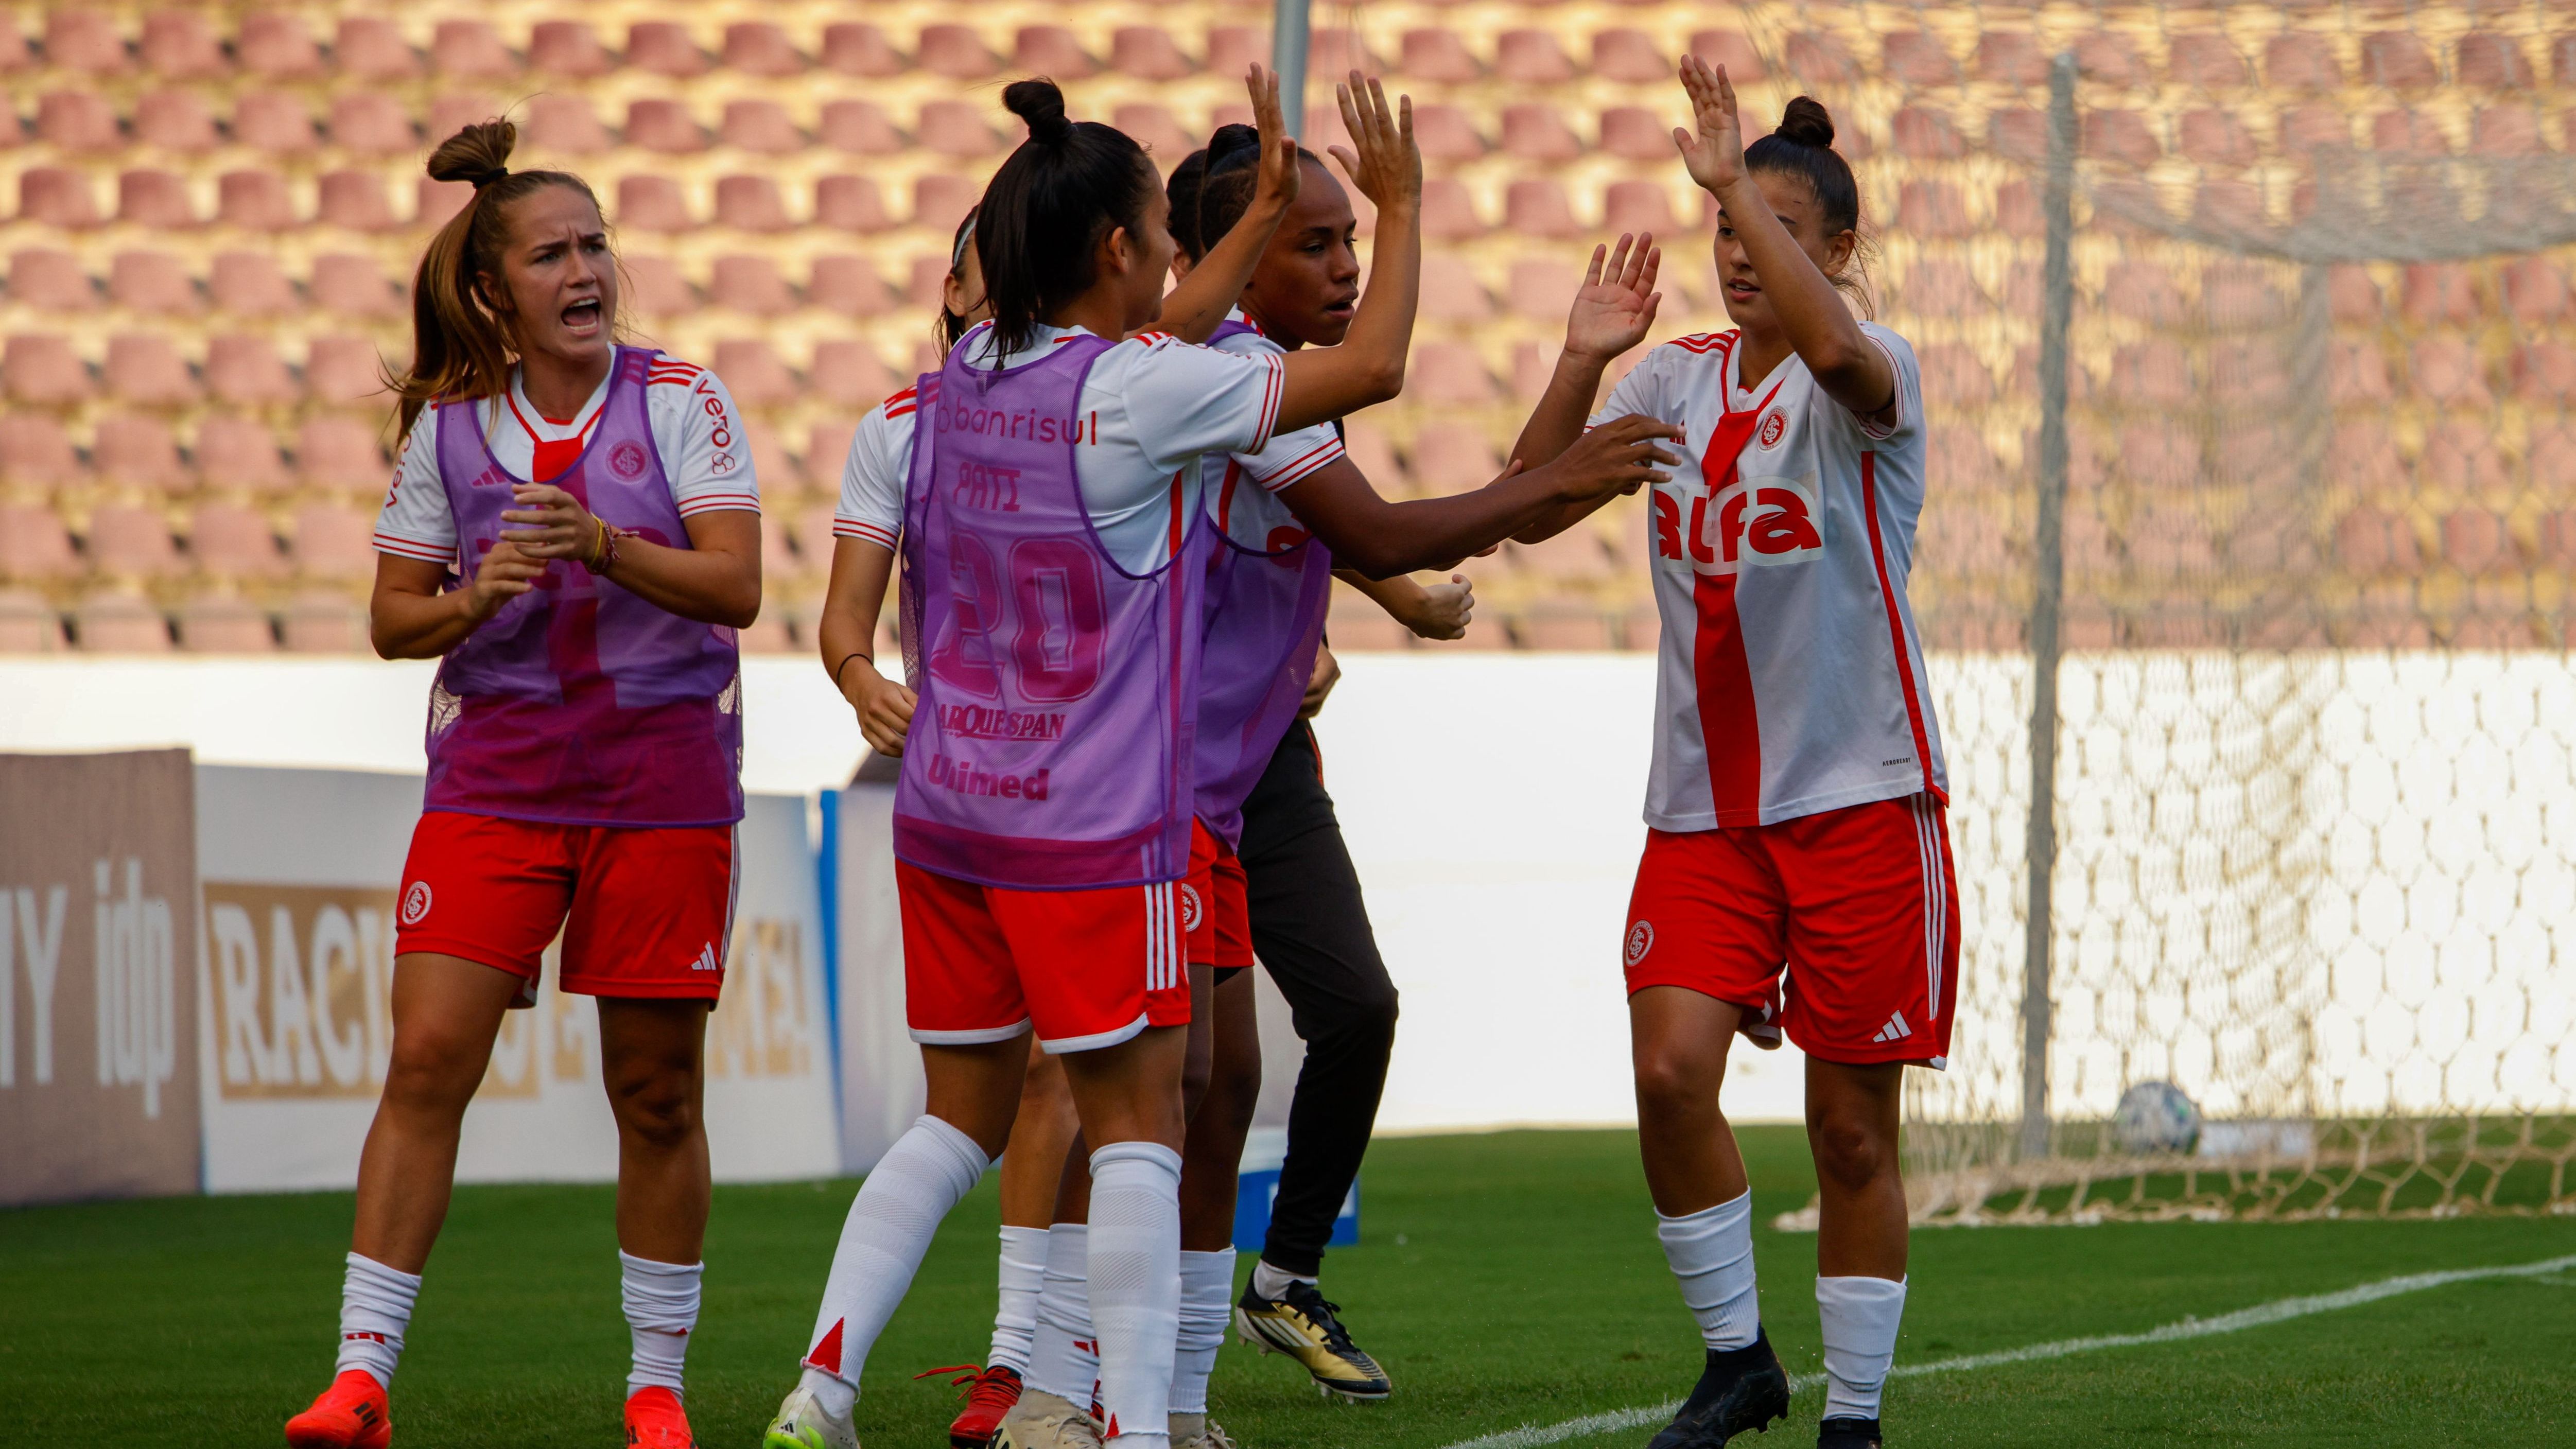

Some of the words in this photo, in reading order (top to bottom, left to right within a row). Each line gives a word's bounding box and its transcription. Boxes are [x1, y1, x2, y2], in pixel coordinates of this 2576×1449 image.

[696, 378, 730, 448] vero
[955, 396, 1096, 445] banrisul
[953, 462, 1021, 512] PATI
[1654, 487, 1822, 564] alfa
[929, 528, 1108, 703] 20
